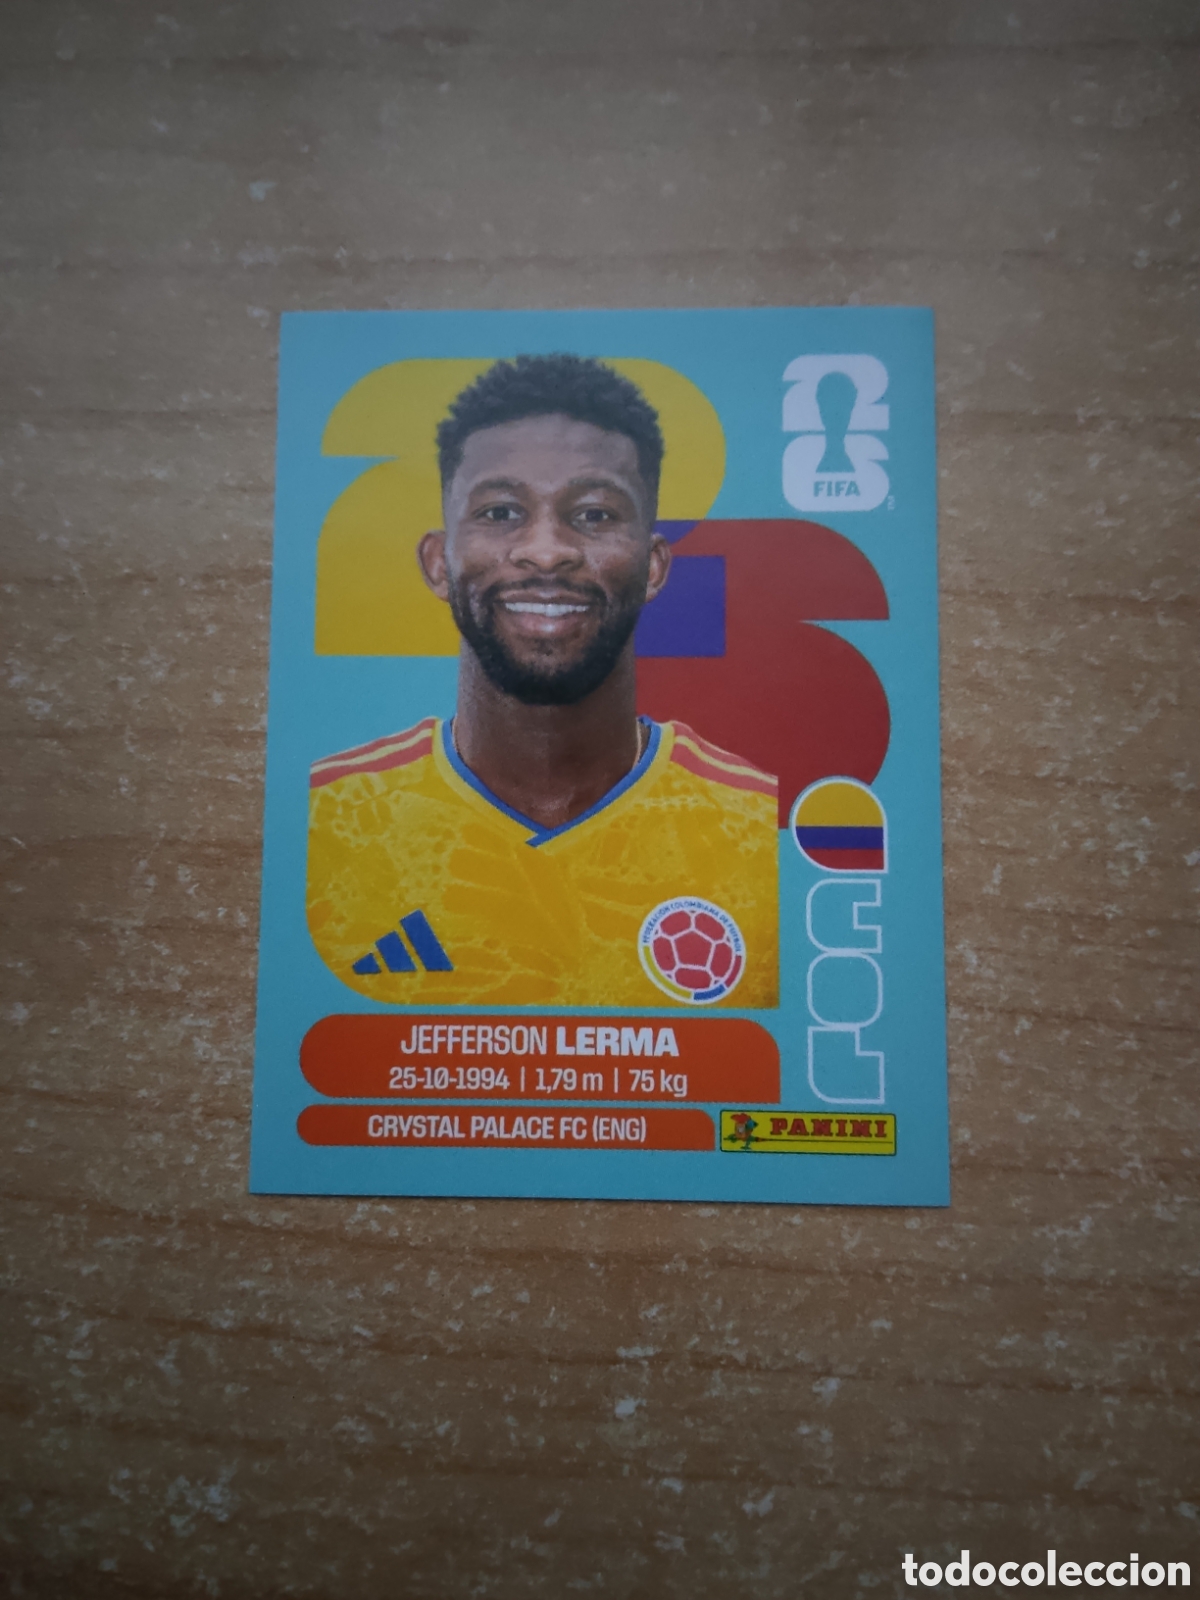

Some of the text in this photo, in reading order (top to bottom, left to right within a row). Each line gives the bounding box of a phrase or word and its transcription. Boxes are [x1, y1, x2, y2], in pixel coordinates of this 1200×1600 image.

[813, 480, 861, 497] FIFA
[400, 1025, 680, 1057] JEFFERSON LERMA
[389, 1066, 510, 1090] 25-10-1994
[535, 1068, 577, 1093] 1,79
[582, 1073, 603, 1091] m
[628, 1069, 655, 1092] 75
[660, 1069, 688, 1098] kg
[367, 1115, 647, 1142] CRYSTAL PALACE FC (ENG)
[770, 1117, 888, 1138] PANINI
